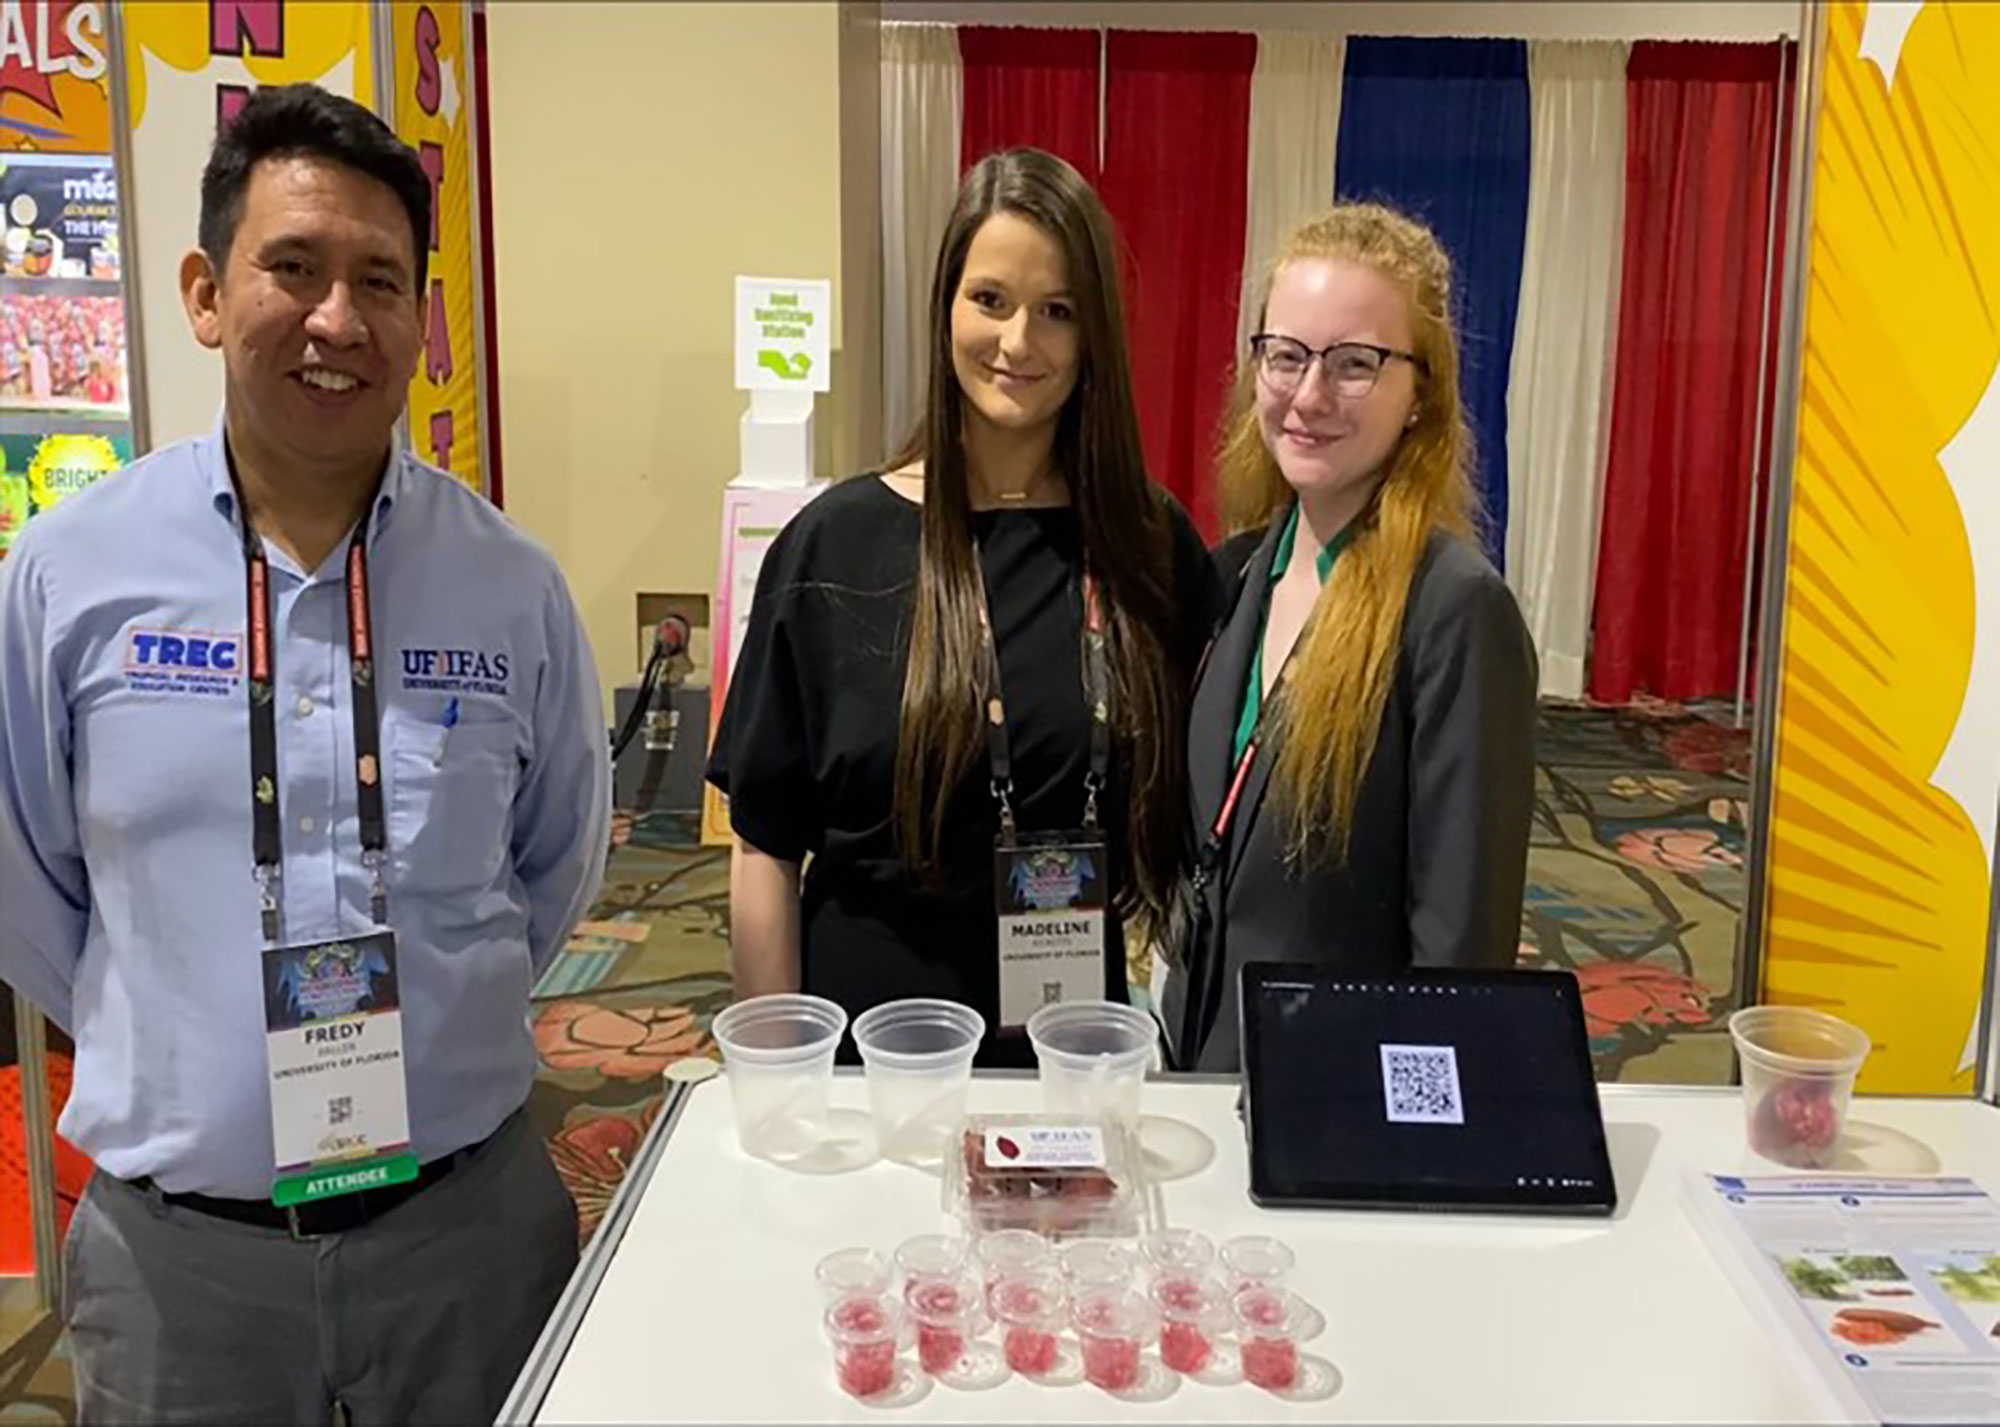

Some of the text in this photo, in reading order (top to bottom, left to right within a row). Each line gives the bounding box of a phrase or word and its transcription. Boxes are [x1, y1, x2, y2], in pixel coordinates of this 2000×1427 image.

[0, 2, 106, 79] ALS
[133, 634, 236, 669] TREC
[1012, 920, 1091, 937] MADELINE
[304, 1021, 366, 1045] FREDY
[273, 1048, 401, 1079] UNIVERSITY OF FLORIDA
[305, 1166, 389, 1195] ATTENDEE
